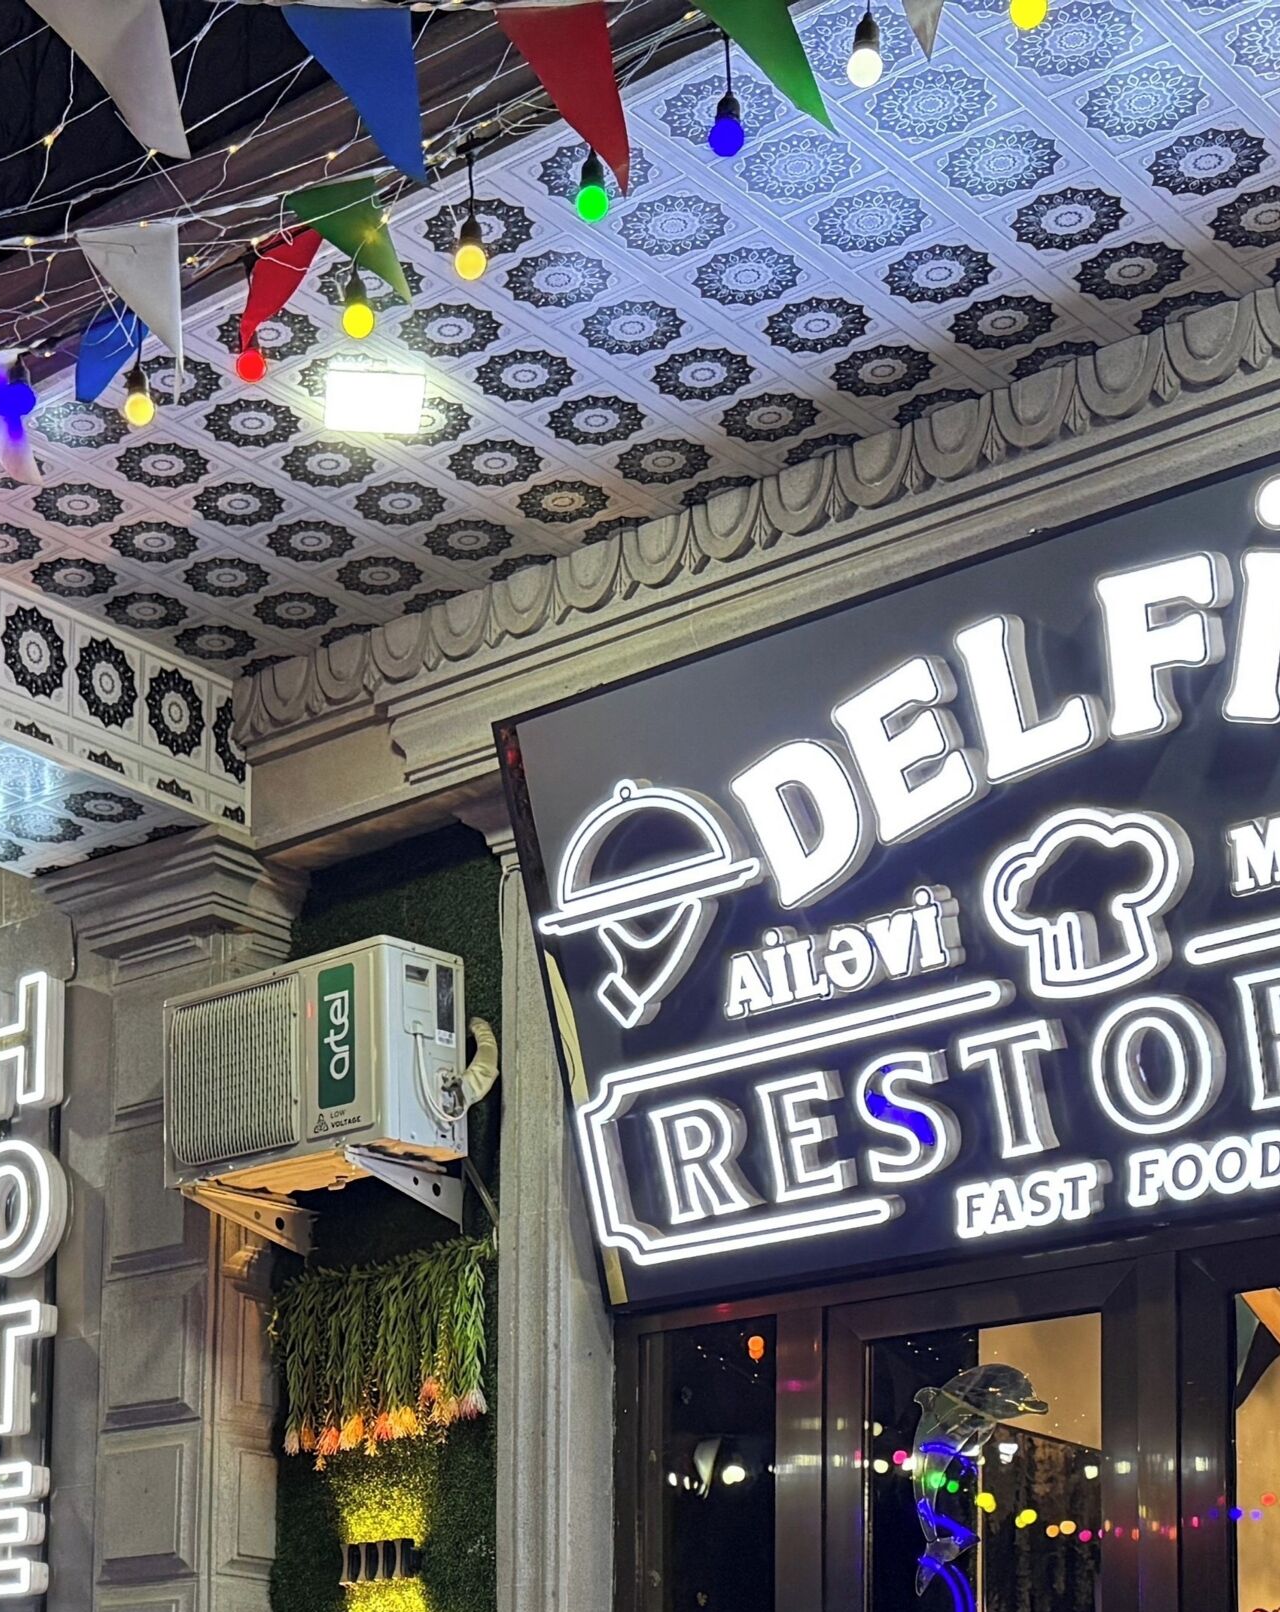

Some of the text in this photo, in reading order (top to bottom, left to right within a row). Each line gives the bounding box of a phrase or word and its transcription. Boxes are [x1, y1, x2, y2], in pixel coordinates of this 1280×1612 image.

[324, 990, 350, 1081] artel
[331, 1116, 362, 1128] VOLTAGE
[956, 1160, 1102, 1240] FAST
